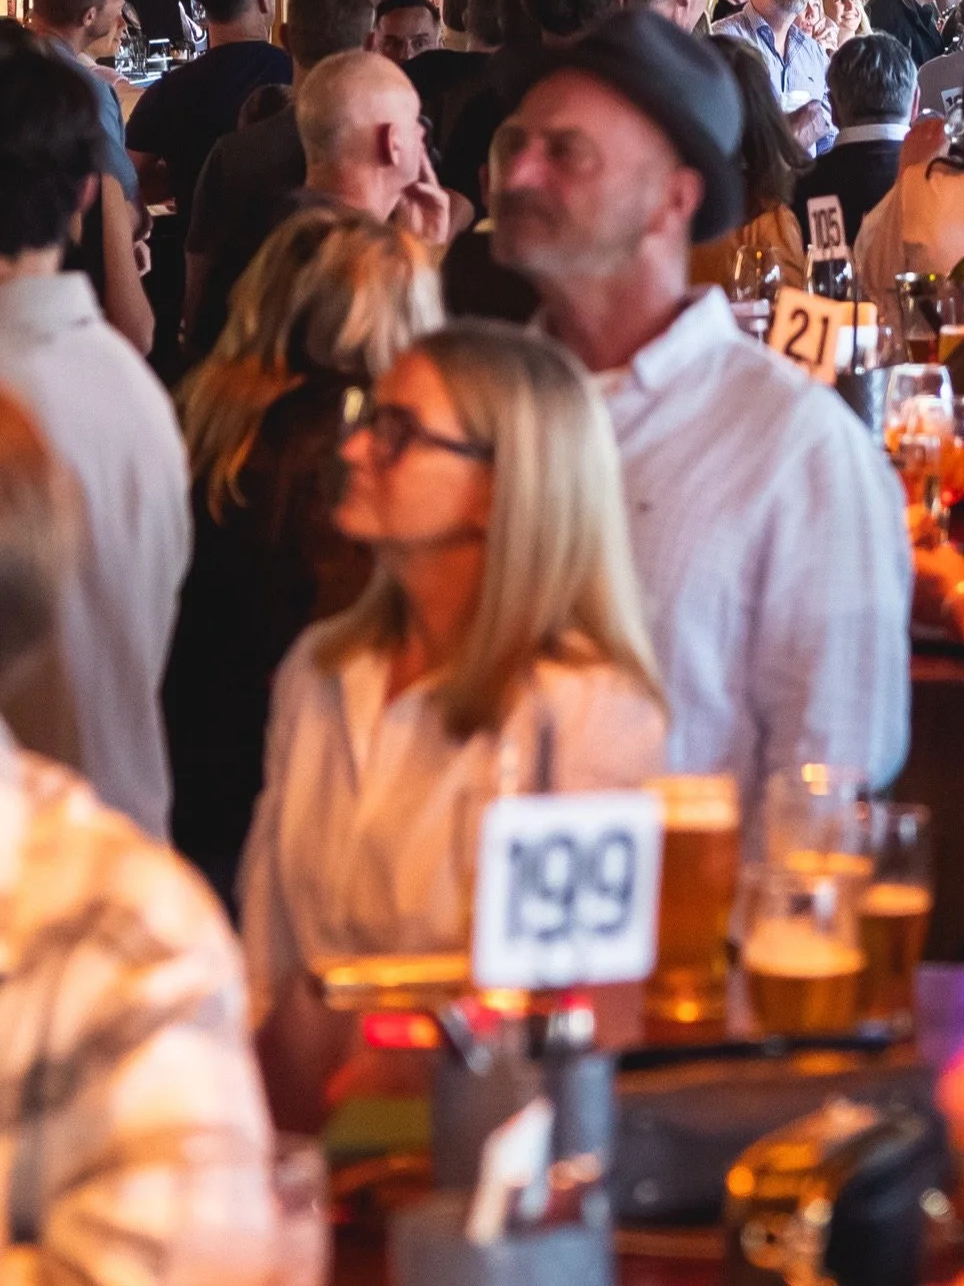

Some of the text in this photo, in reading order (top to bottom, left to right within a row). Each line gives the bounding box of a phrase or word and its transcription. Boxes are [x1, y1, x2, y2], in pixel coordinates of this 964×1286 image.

[812, 207, 841, 250] 105
[784, 308, 830, 364] 21
[508, 826, 637, 943] 199
